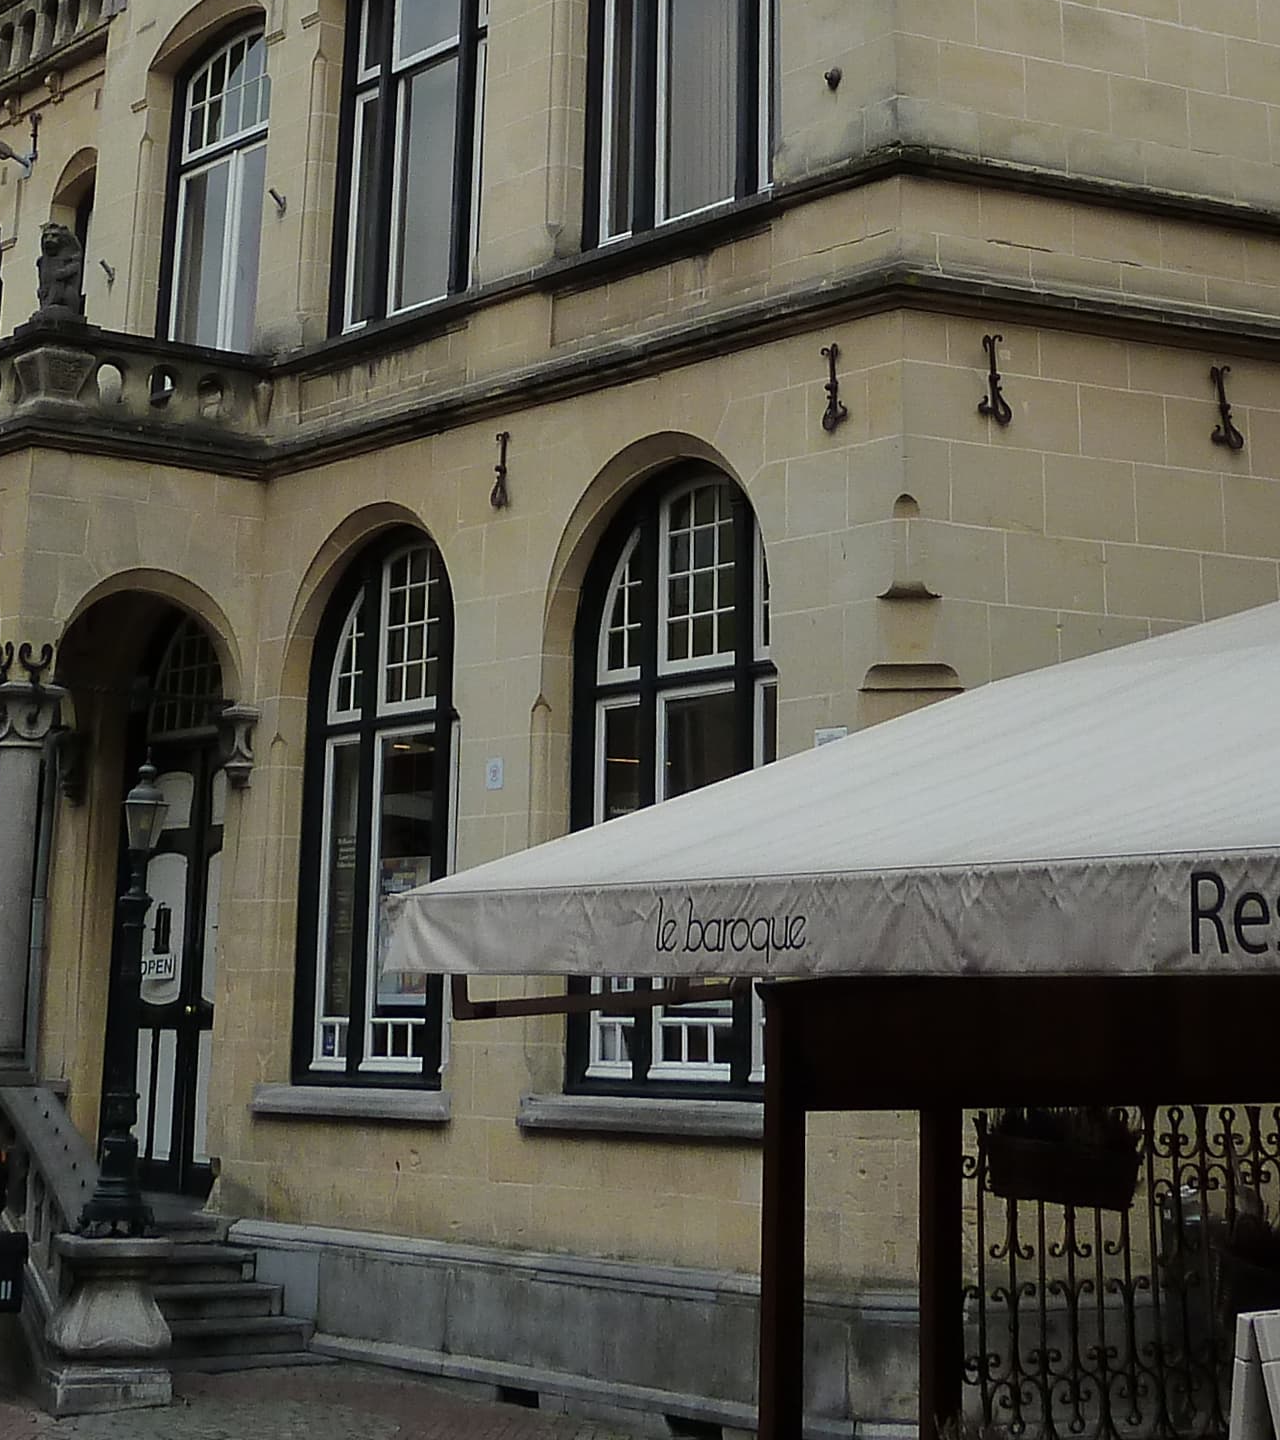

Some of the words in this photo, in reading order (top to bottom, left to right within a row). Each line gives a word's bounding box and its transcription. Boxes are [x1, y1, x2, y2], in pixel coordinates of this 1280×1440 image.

[656, 897, 677, 952] le
[682, 897, 806, 963] baroque
[140, 958, 172, 975] OPEN
